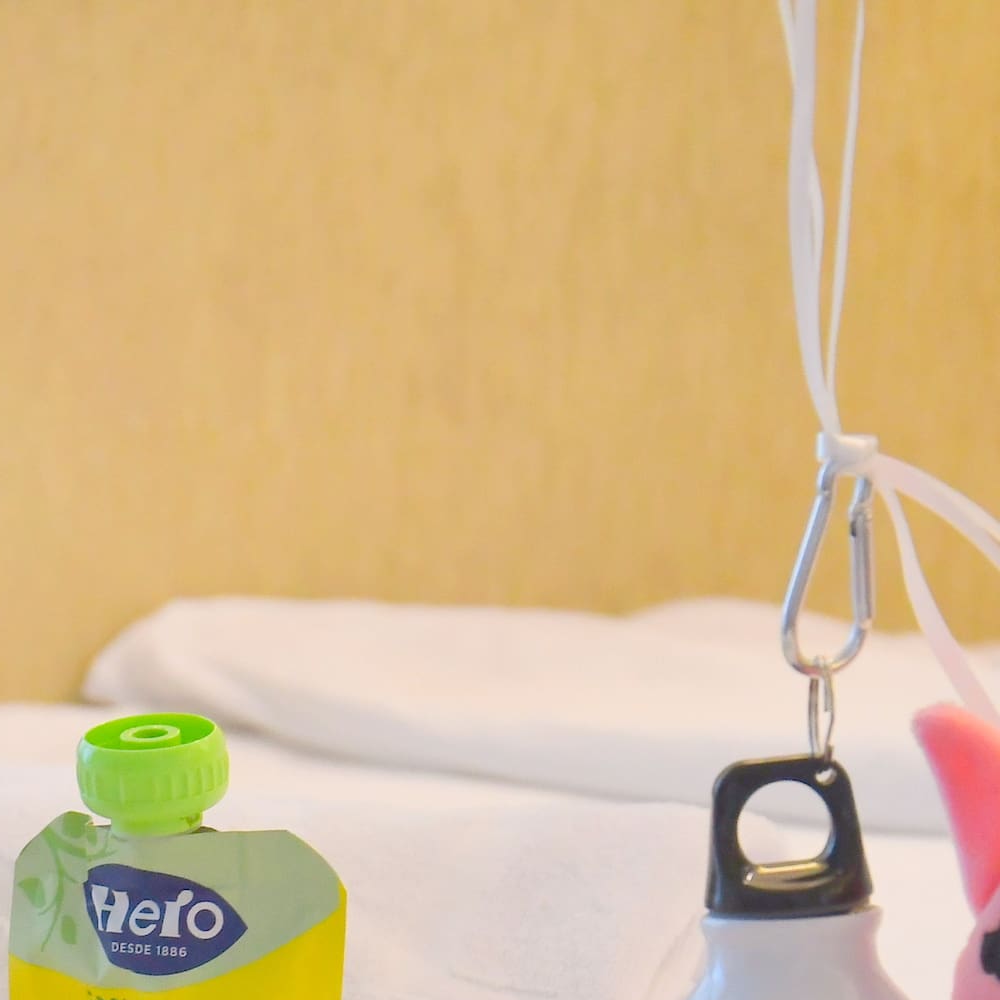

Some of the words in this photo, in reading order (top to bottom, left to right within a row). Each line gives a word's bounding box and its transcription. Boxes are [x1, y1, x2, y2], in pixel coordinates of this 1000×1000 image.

[91, 883, 224, 940] Hero
[111, 941, 151, 955] DESDE
[156, 944, 188, 958] 1886
